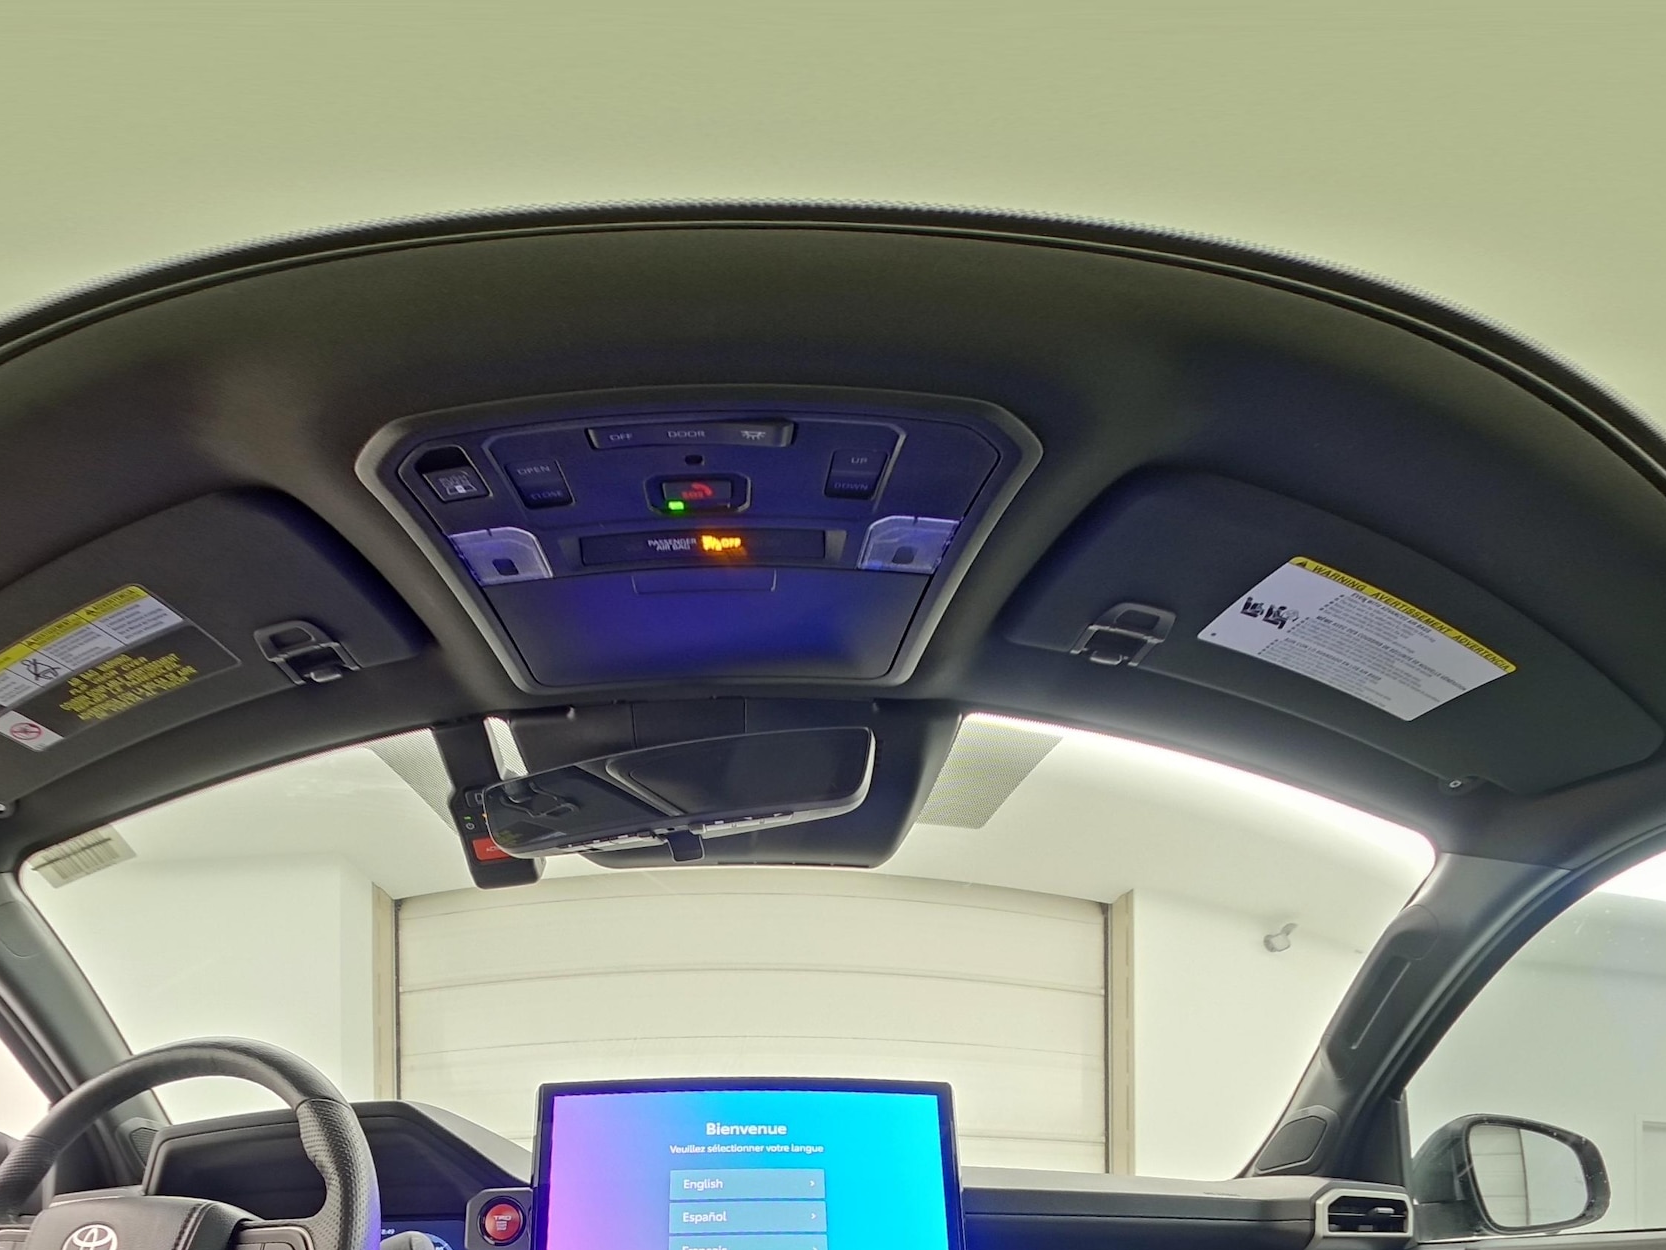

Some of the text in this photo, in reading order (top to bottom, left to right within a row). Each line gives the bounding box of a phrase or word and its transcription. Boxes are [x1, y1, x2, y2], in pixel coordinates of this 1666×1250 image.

[609, 433, 633, 441] OFF
[666, 430, 705, 438] DOOR
[516, 465, 551, 475] OPEN
[834, 482, 869, 490] DOWN
[529, 490, 563, 500] CLOSE
[647, 537, 697, 547] PASSENGER
[1312, 564, 1368, 592] WARNING
[1370, 591, 1451, 635] AVERTISSEMENT
[1452, 634, 1512, 672] ADVERTENCIA
[706, 1122, 788, 1136] Bienvenue
[669, 1143, 824, 1155] Veuillez sélectionner votre langue
[683, 1178, 723, 1191] English
[682, 1211, 727, 1224] Español
